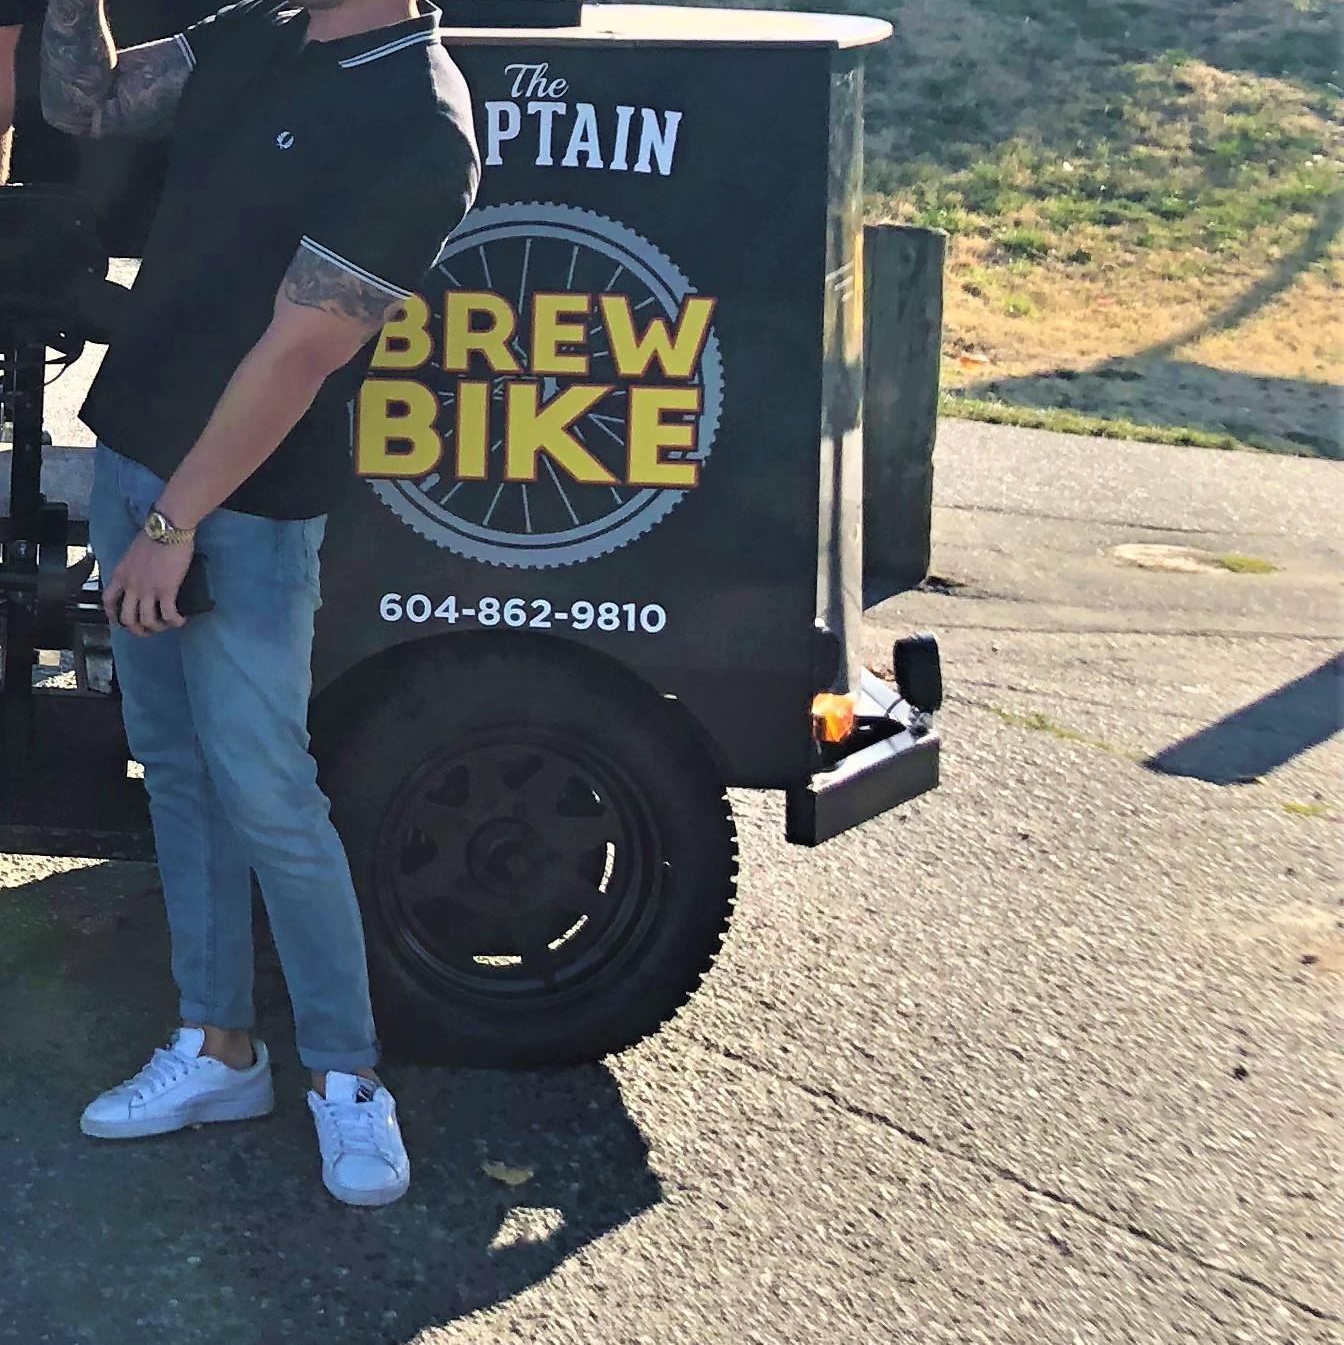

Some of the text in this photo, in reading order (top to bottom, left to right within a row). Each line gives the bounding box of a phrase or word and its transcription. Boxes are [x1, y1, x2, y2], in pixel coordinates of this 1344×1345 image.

[505, 63, 570, 98] The
[484, 101, 683, 175] PTAIN
[368, 289, 718, 378] BREW
[354, 376, 703, 488] BIKE
[379, 593, 667, 633] 604-862-9810
